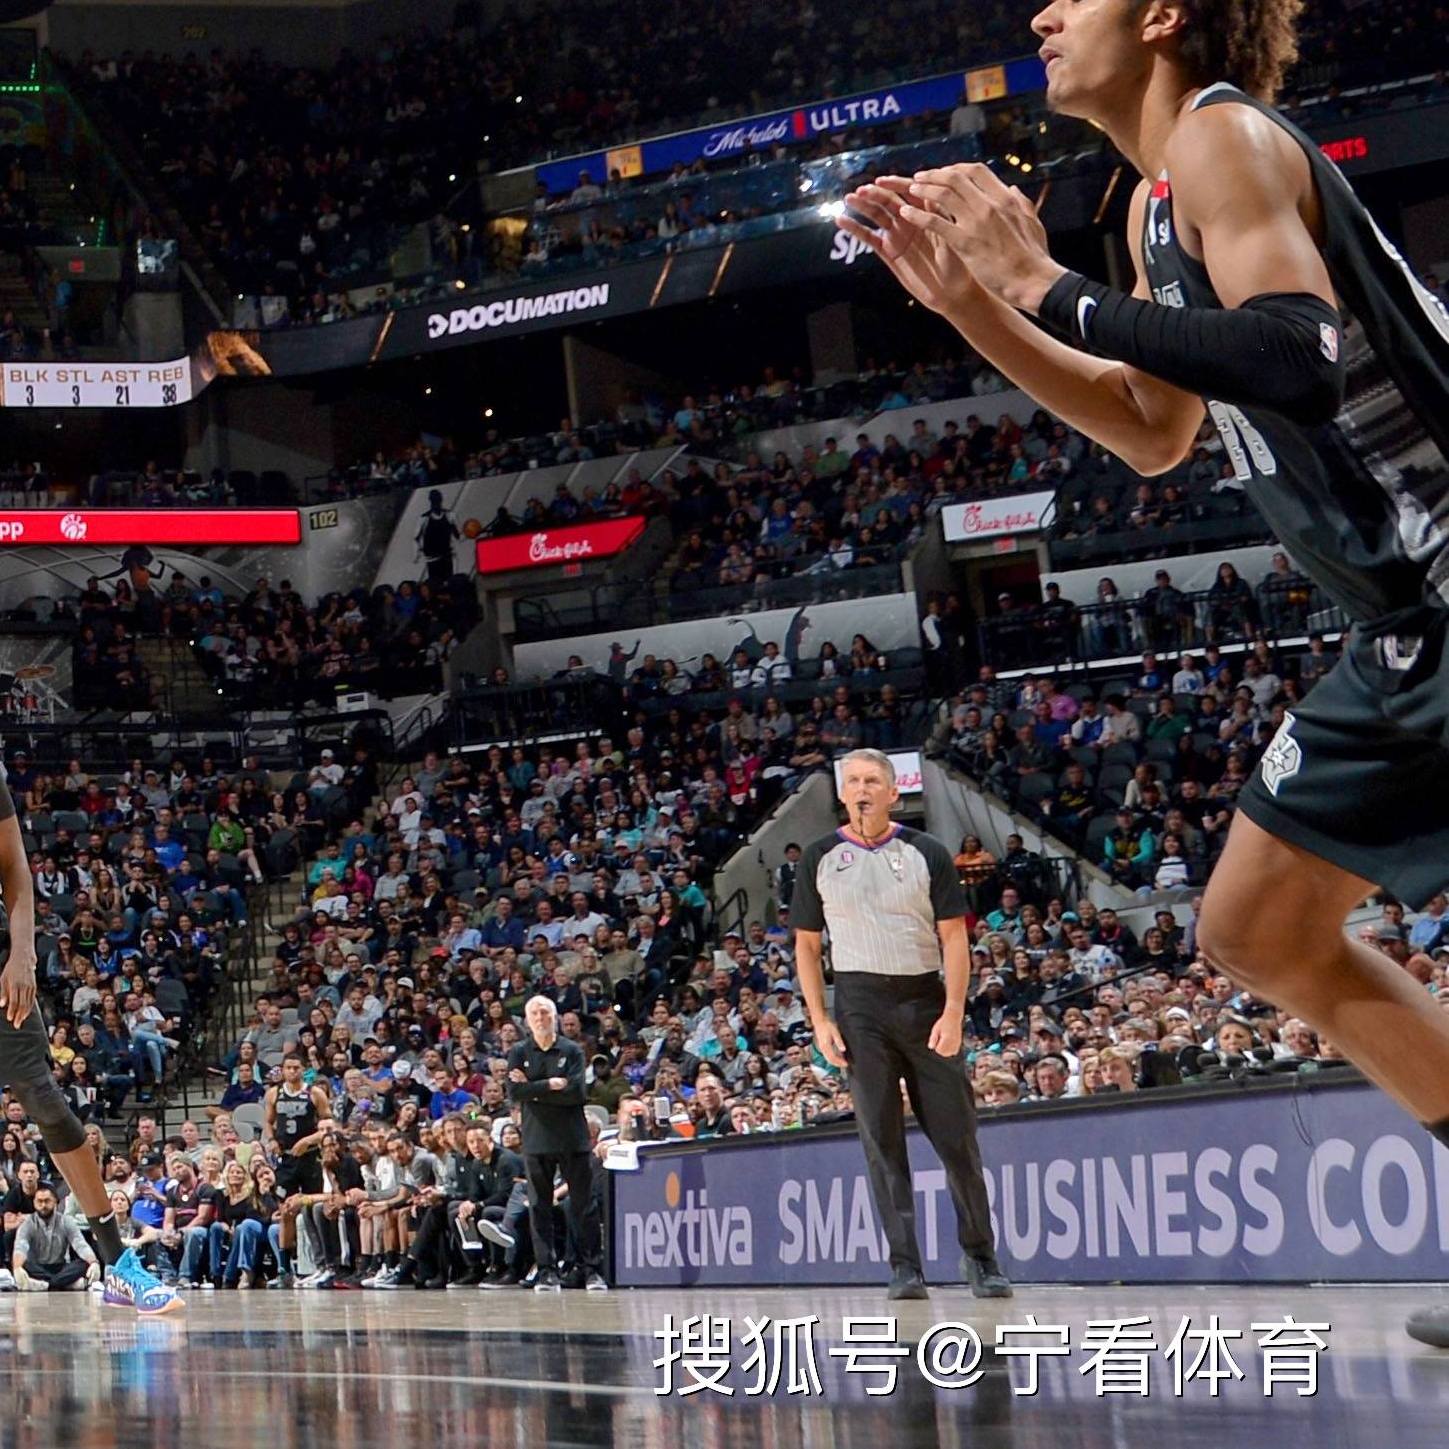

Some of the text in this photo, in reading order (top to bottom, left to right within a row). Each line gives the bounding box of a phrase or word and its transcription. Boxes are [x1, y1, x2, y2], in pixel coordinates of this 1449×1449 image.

[811, 94, 901, 132] ULTRA
[449, 283, 609, 335] DOCUMATION
[9, 365, 185, 384] BLK STL AST REB
[26, 383, 177, 405] 3 3 21 38
[311, 510, 336, 528] 102
[624, 1172, 753, 1268] nextiva
[778, 1170, 947, 1265] SMAT
